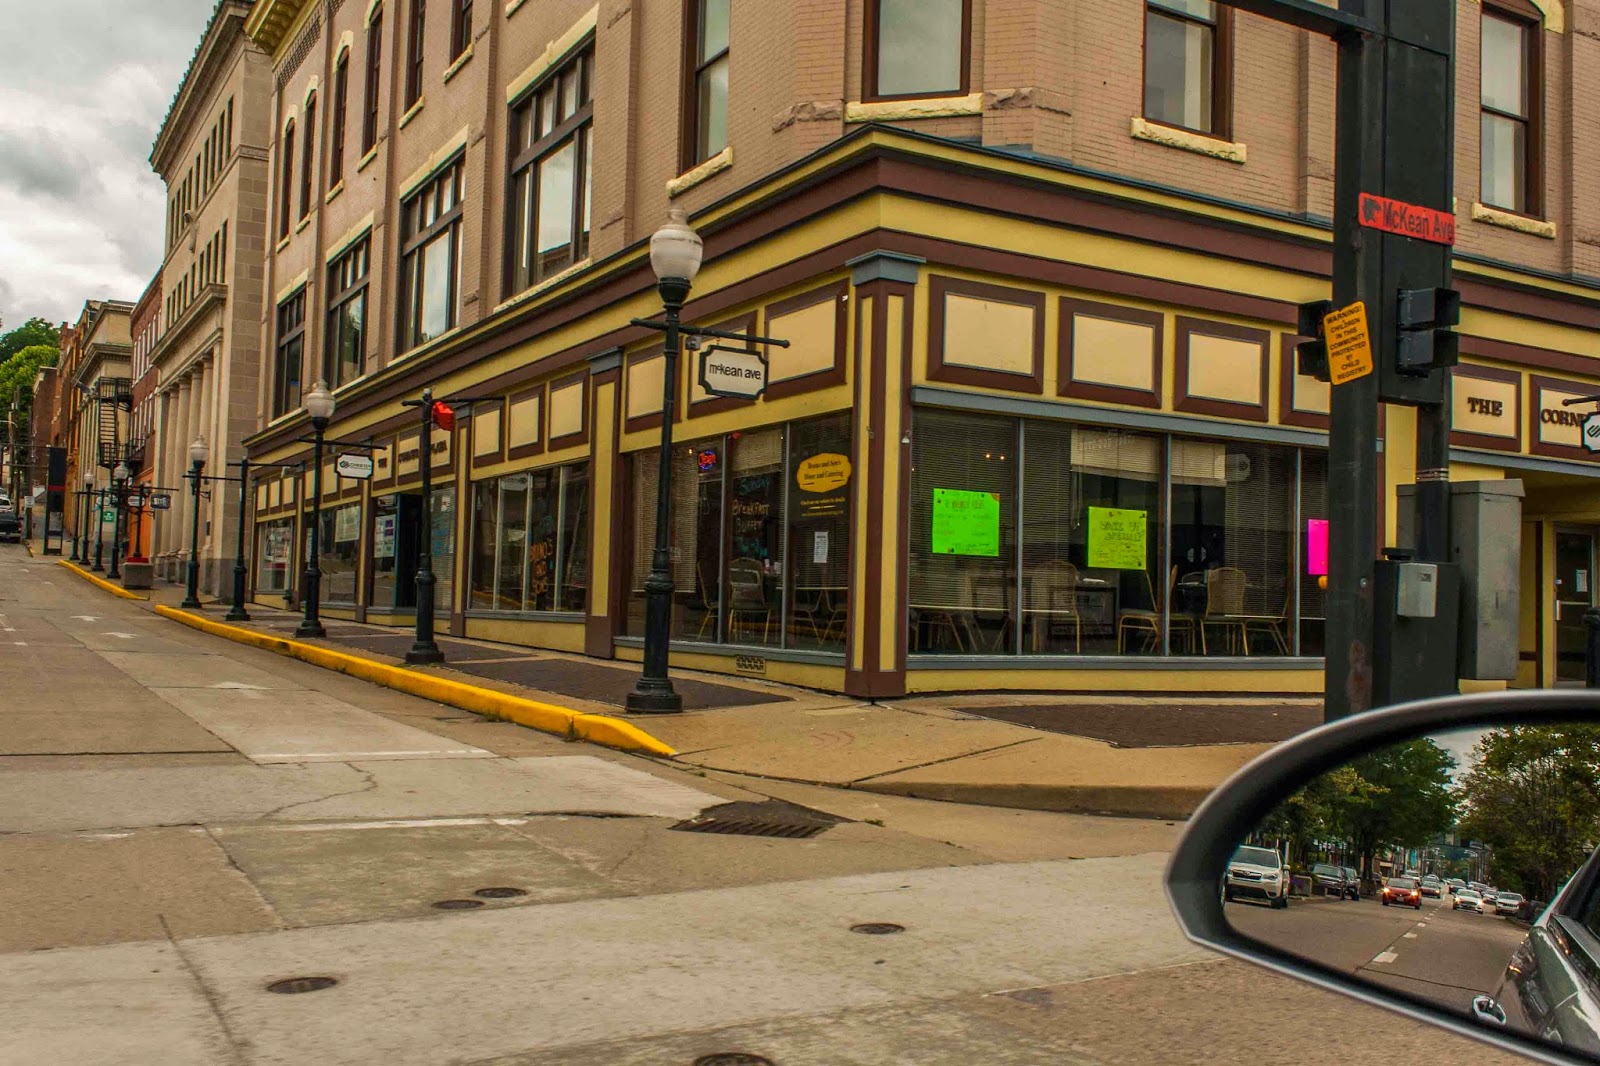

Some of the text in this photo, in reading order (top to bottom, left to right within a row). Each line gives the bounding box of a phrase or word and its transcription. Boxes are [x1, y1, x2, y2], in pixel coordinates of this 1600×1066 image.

[1383, 201, 1430, 236] McKean
[1325, 305, 1362, 325] WARNING!
[1330, 317, 1361, 333] CHILDREN
[1343, 327, 1358, 337] THIS
[1329, 333, 1366, 350] COMMUNITY
[1331, 341, 1366, 358] PROTECTED
[1337, 365, 1367, 380] REGISTRY
[1341, 359, 1360, 371] CHILD
[1467, 396, 1503, 417] THE
